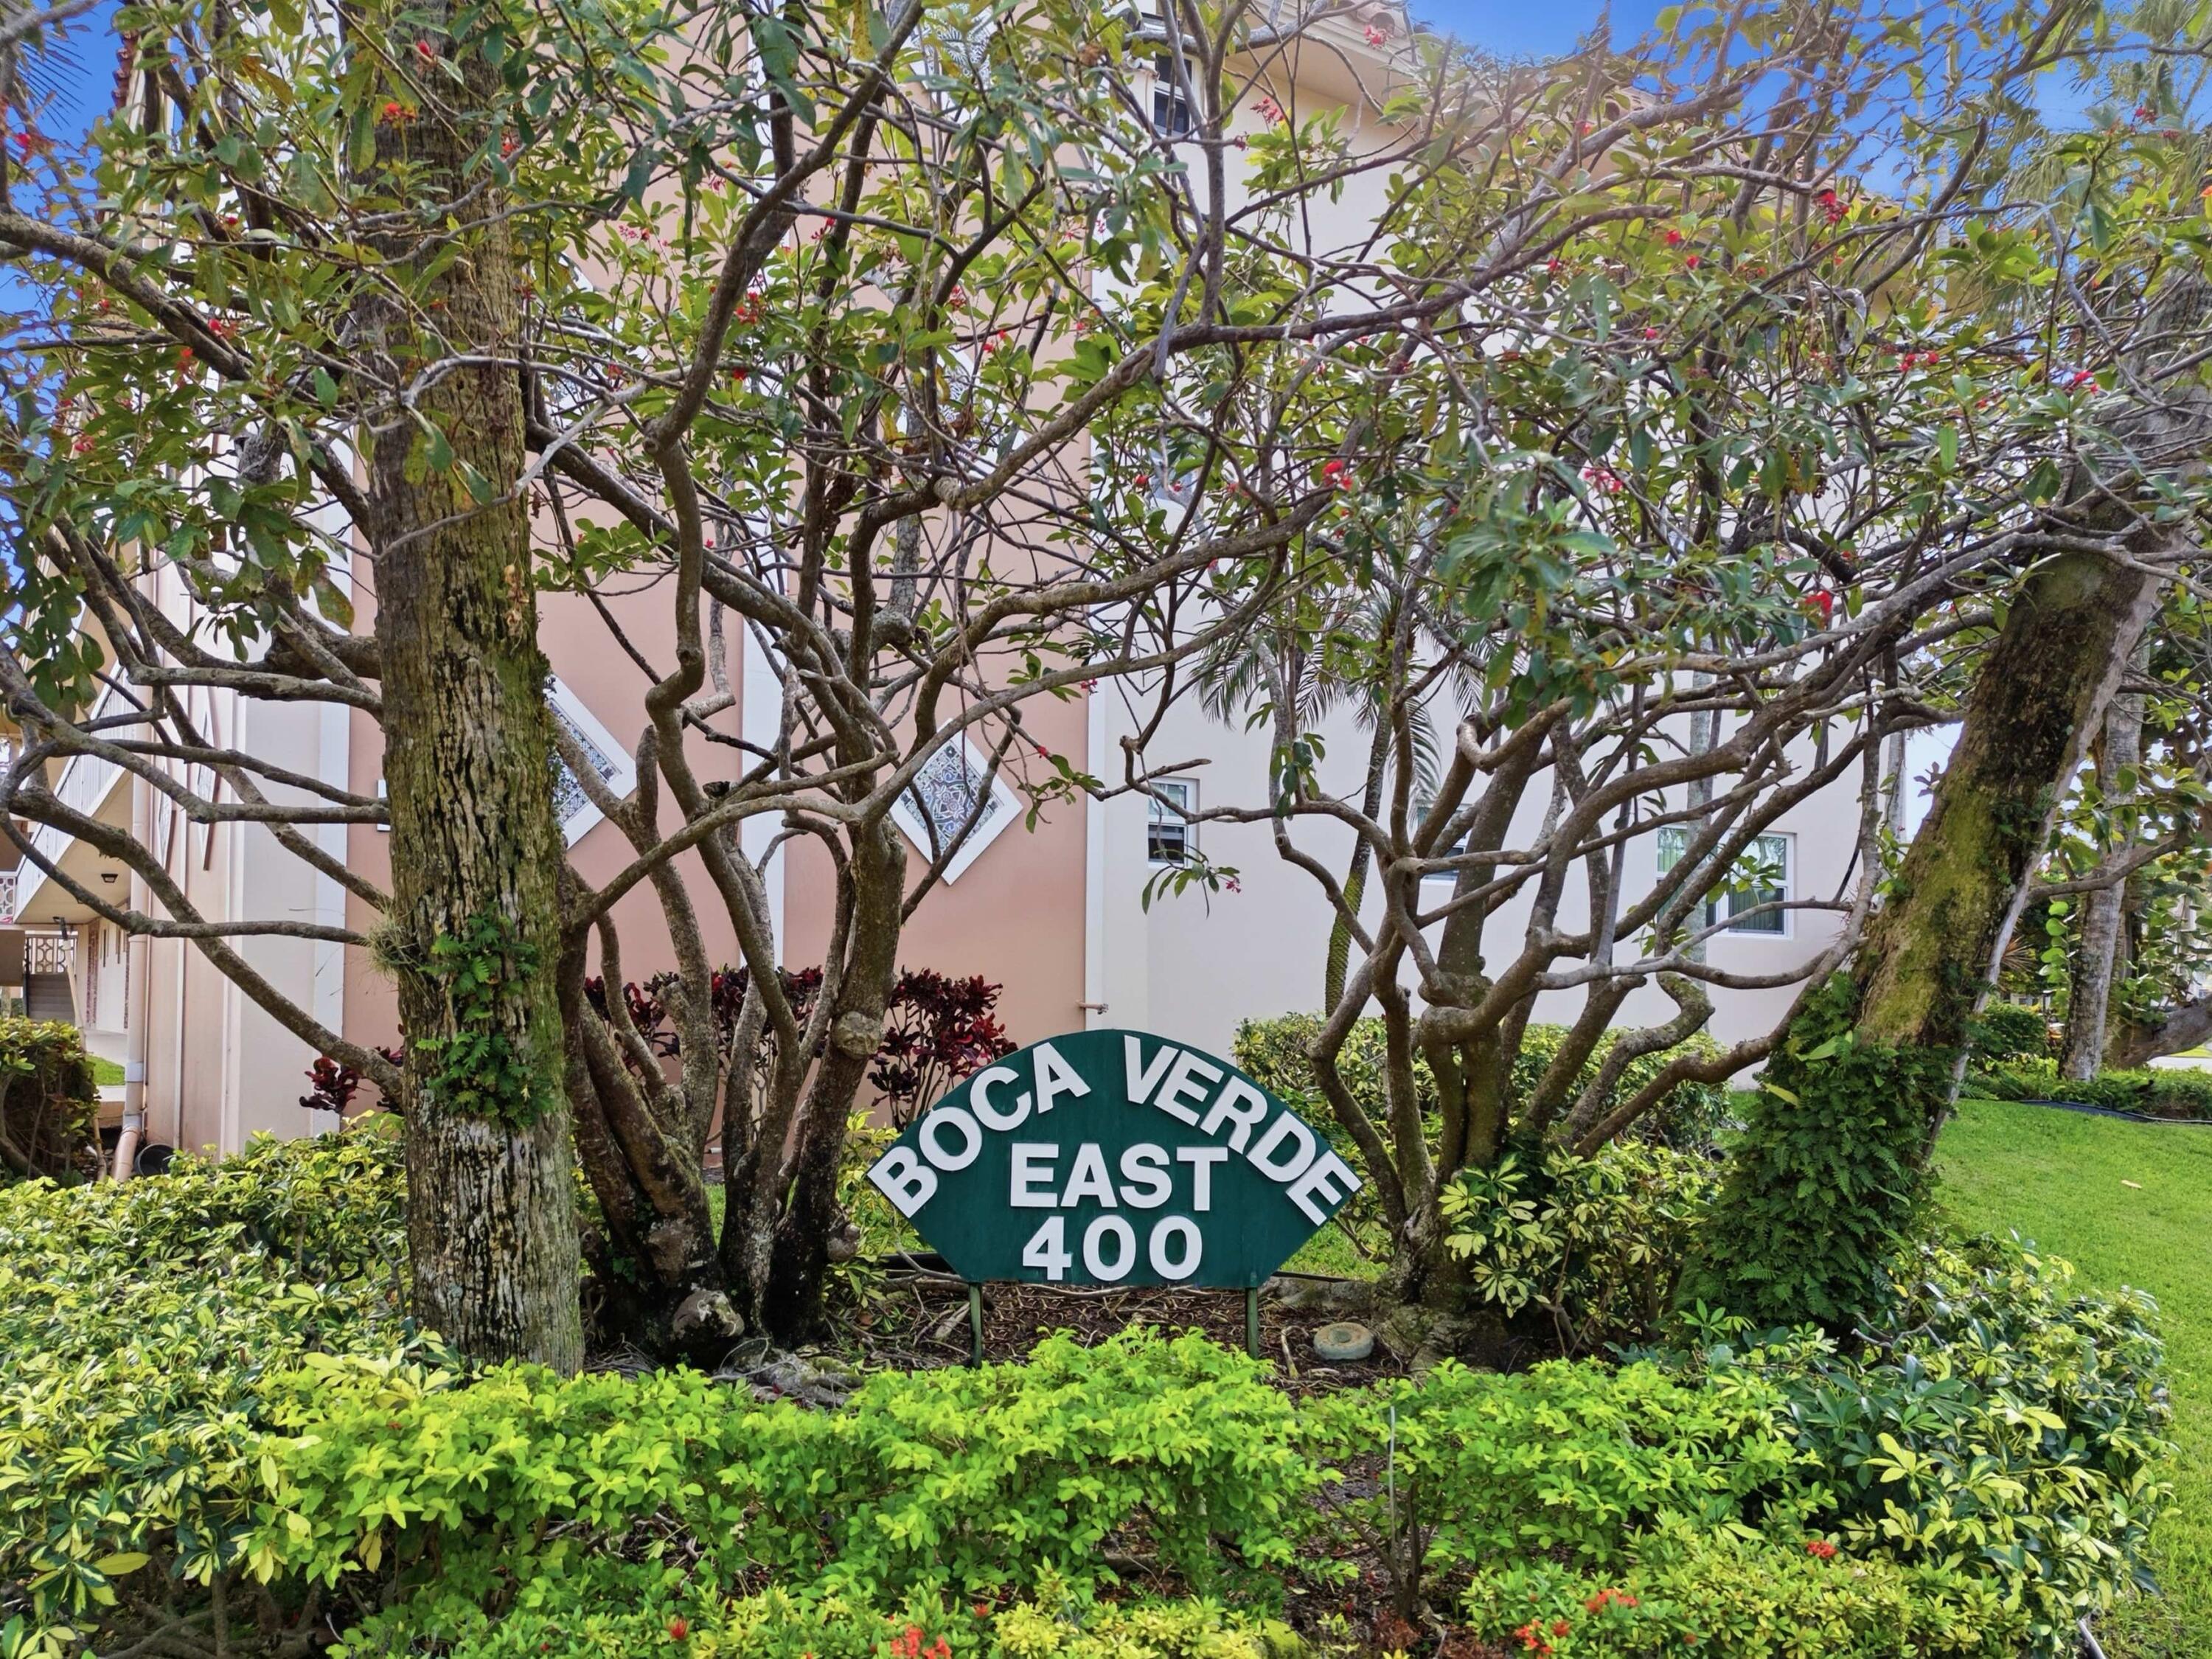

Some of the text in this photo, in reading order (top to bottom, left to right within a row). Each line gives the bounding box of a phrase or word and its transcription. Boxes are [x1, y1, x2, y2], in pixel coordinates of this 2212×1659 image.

[867, 1034, 1363, 1226] BOCA VERDE
[1010, 1143, 1228, 1211] EAST
[1023, 1215, 1203, 1281] 400
